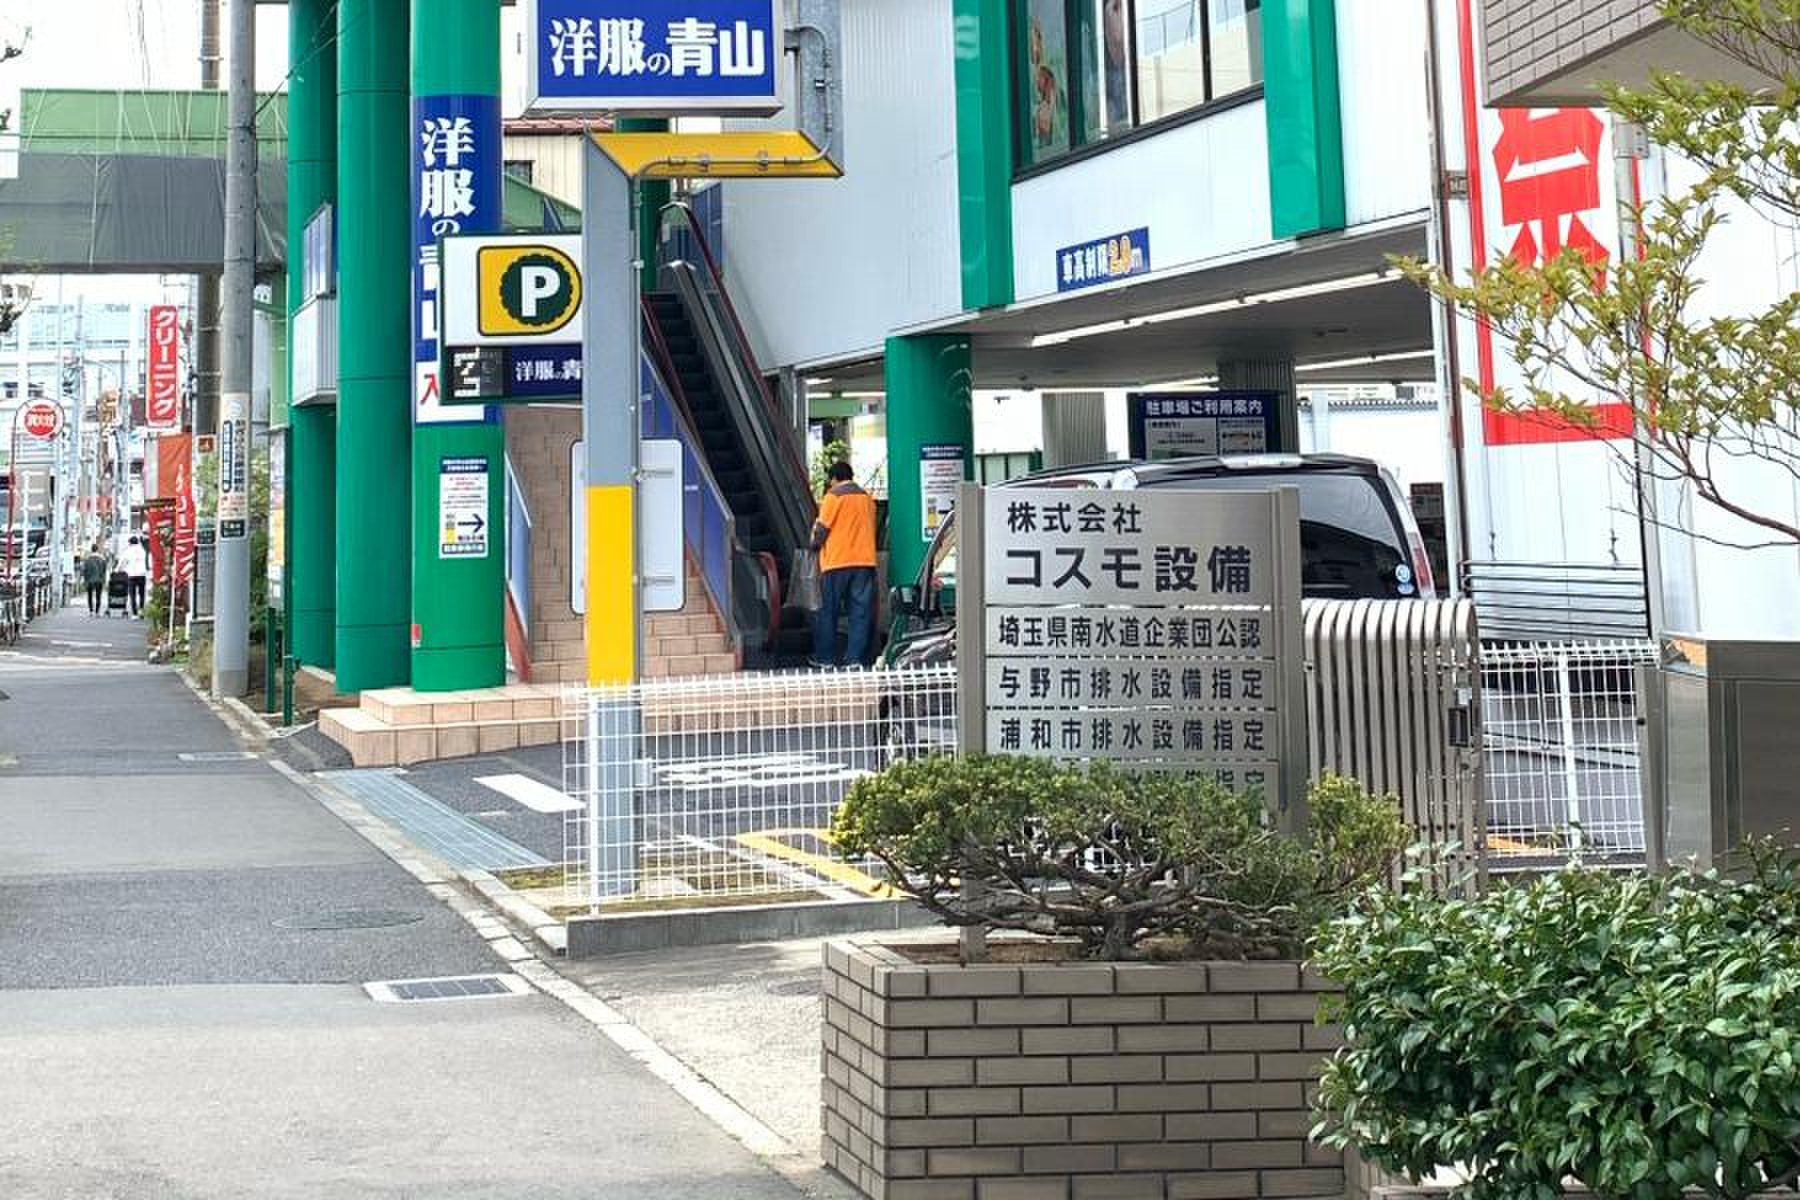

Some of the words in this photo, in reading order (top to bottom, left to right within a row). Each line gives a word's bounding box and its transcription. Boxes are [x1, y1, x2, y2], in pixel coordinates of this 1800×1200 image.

[549, 16, 765, 77] 洋服の青山
[520, 265, 561, 317] P
[153, 309, 177, 416] クリーニング
[1145, 399, 1263, 416] 駐車場ご利用案内
[1007, 502, 1143, 535] 株式会社
[1006, 545, 1251, 593] コスモ設備
[999, 617, 1261, 650] 埼玉県南水道企業団公認
[999, 666, 1263, 701] 与野市排水設備指定
[1000, 717, 1265, 751] 浦和市排水設備指定
